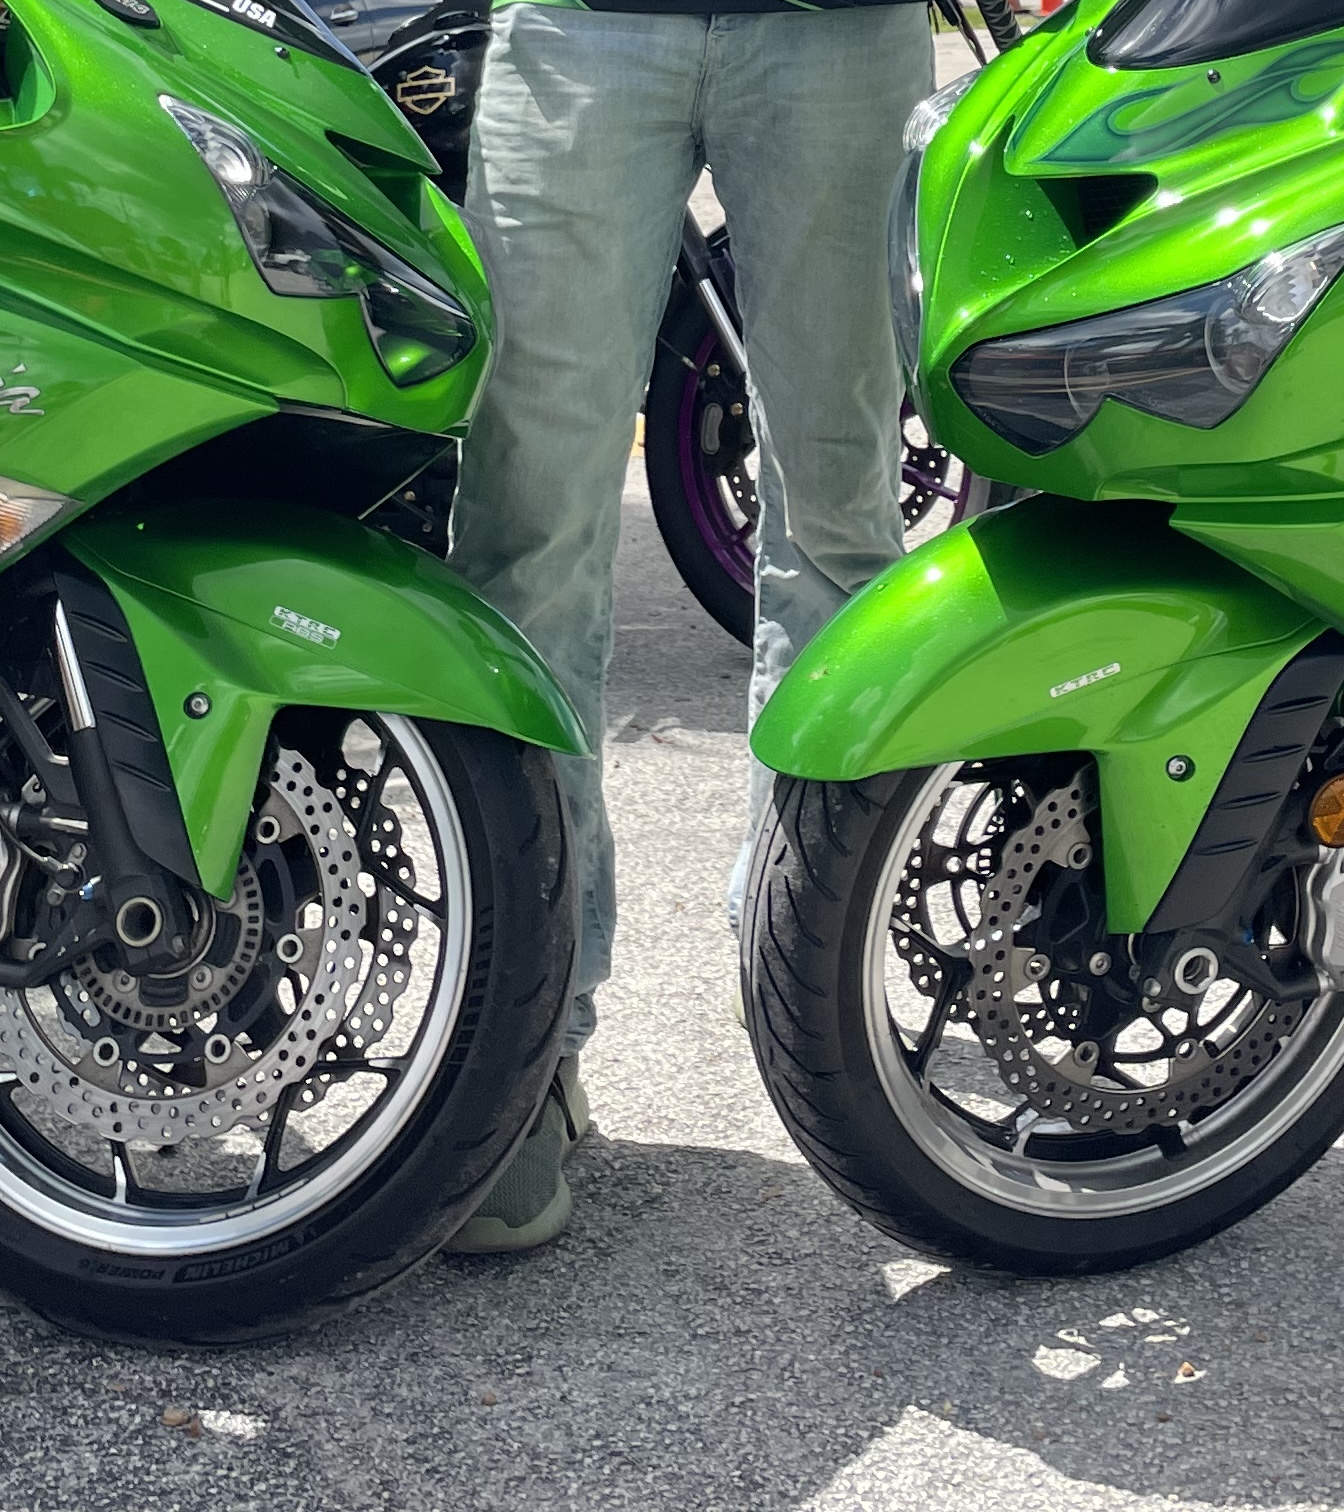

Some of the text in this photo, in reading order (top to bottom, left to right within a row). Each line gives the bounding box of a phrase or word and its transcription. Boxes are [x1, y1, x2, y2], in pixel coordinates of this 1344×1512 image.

[276, 607, 339, 639] KTRC
[1052, 664, 1118, 696] KTRC
[183, 1239, 290, 1281] MICHELIN
